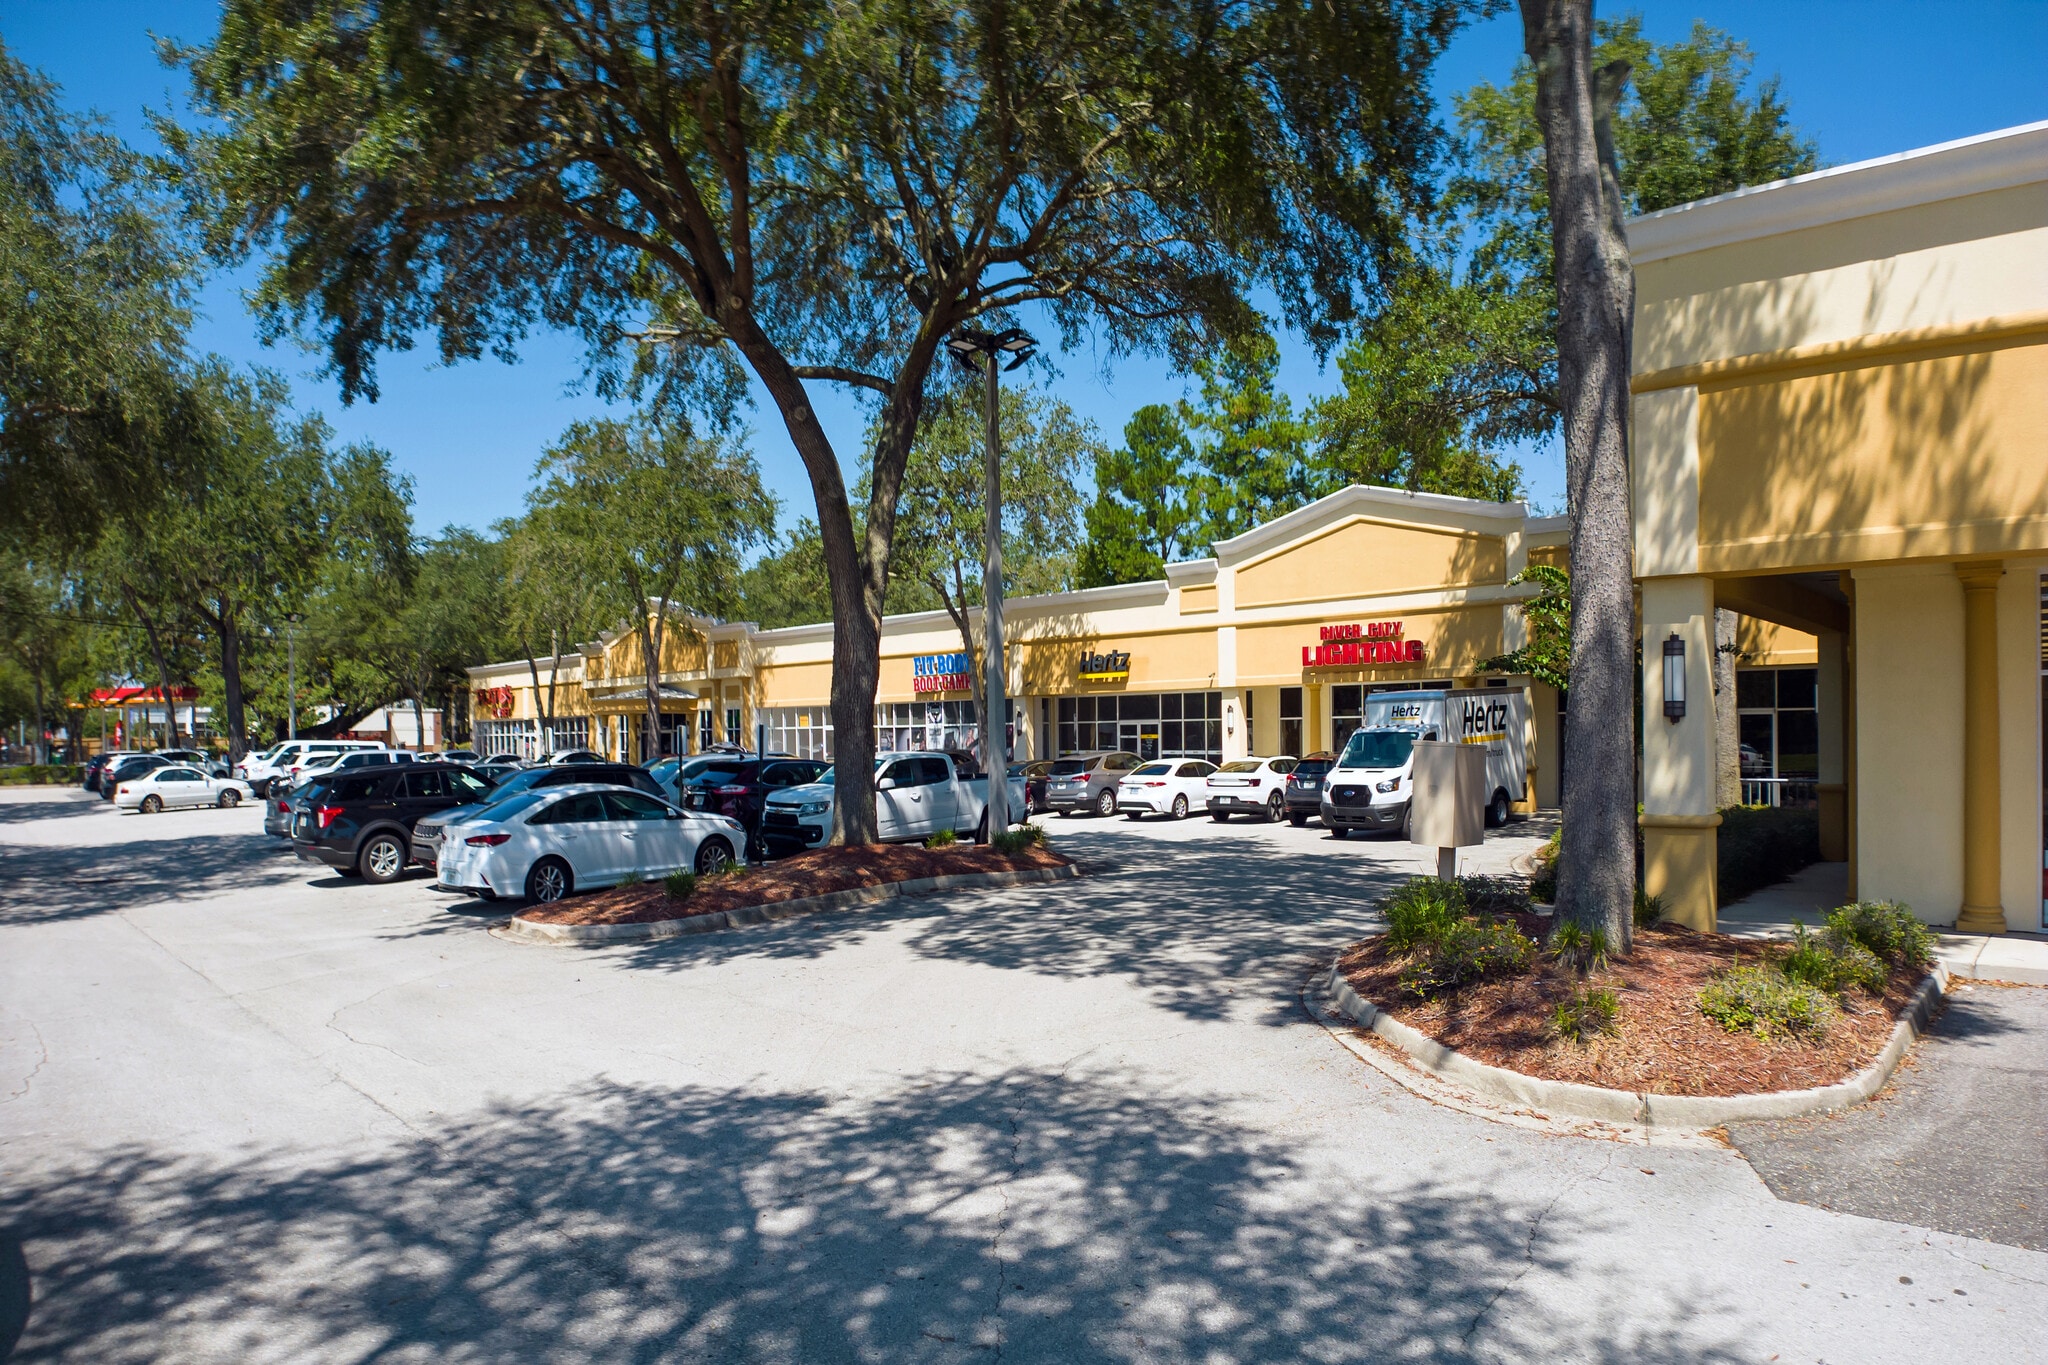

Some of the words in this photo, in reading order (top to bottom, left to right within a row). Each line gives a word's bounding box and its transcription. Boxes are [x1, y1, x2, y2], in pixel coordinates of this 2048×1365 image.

[1320, 625, 1362, 641] RIVER
[1367, 621, 1403, 638] CITY
[1080, 649, 1131, 672] Hertz
[1302, 640, 1424, 668] LIGHTING
[913, 656, 935, 676] FIT
[913, 676, 940, 692] BOOT
[1391, 705, 1420, 717] Hertz
[1462, 699, 1508, 734] Hertz
